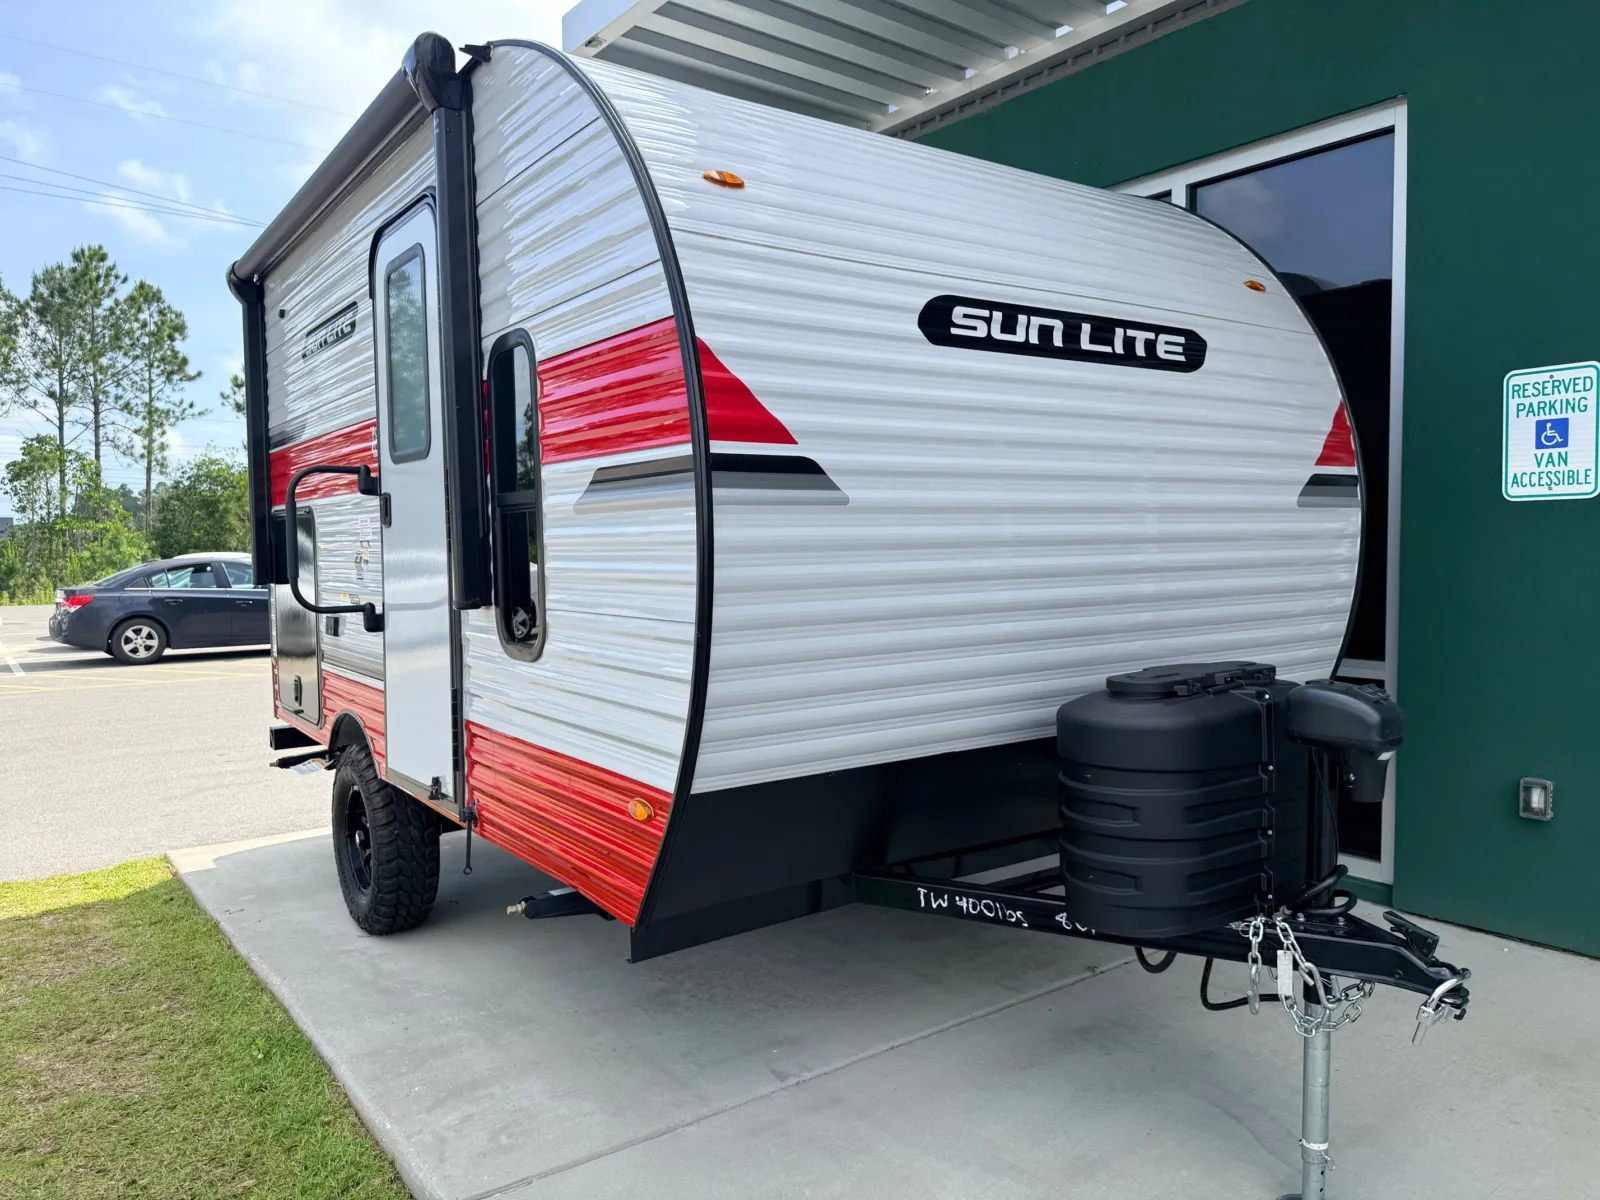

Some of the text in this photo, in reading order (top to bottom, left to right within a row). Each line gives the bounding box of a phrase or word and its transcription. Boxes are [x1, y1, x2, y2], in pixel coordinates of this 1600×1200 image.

[950, 305, 1187, 362] SUN LITE
[1511, 375, 1594, 399] RESERVED
[1516, 396, 1588, 418] PARKING
[1534, 451, 1568, 468] VAN
[1511, 468, 1592, 488] ACCESSIBLE
[917, 887, 948, 908] TW
